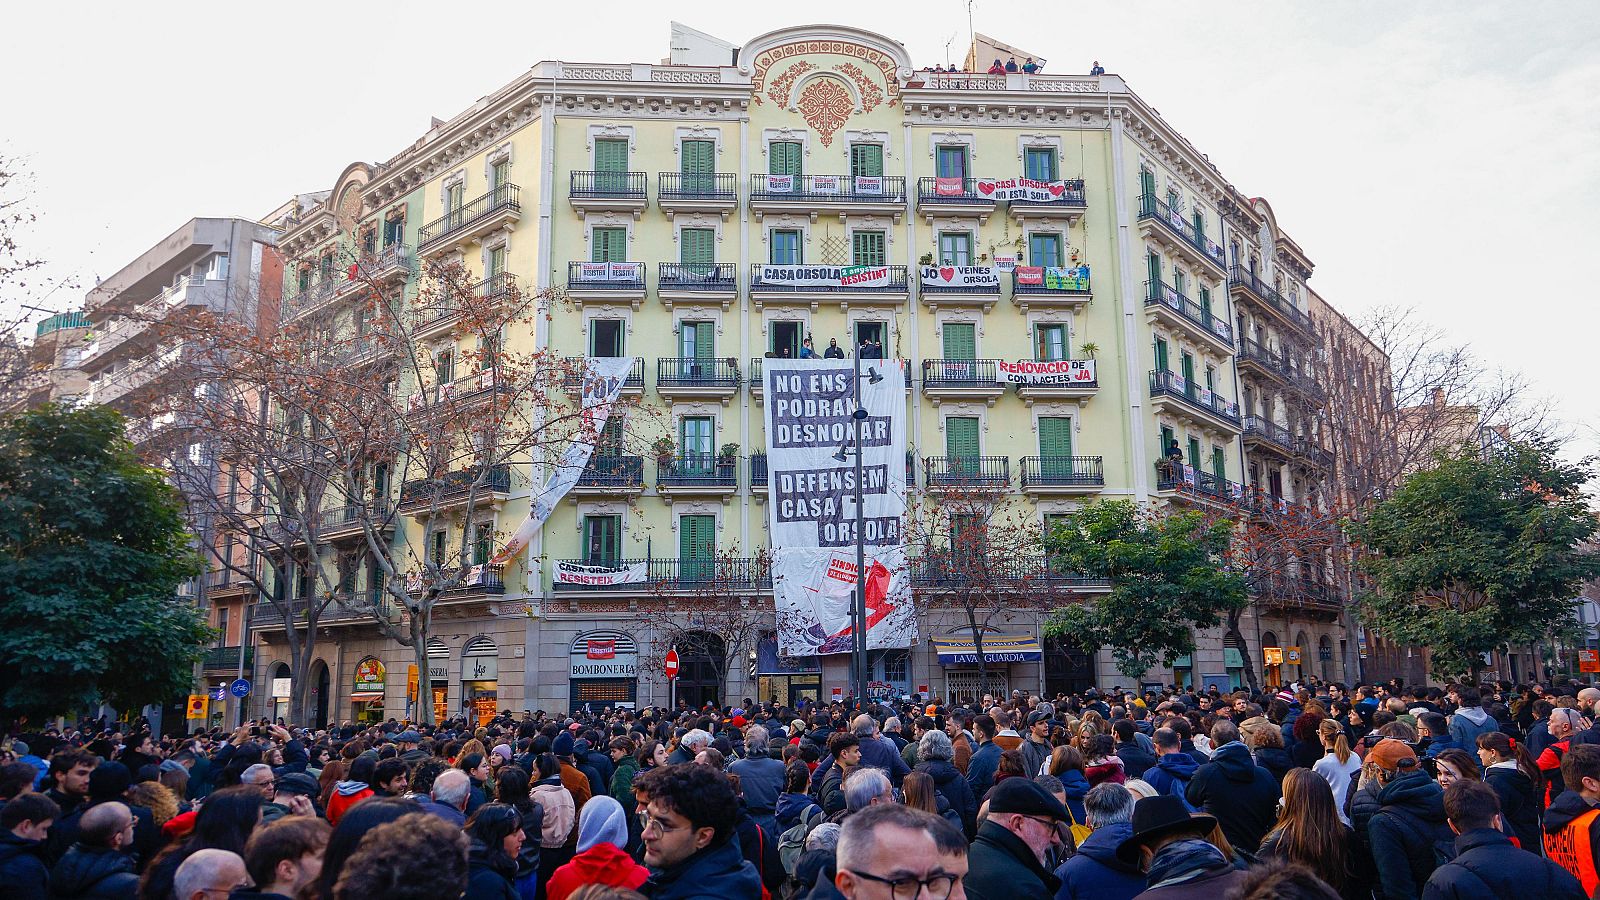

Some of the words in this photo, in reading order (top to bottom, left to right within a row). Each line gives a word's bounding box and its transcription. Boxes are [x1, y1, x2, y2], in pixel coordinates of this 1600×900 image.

[995, 179, 1016, 189] CASA
[995, 190, 1006, 199] NO
[1031, 191, 1050, 200] SOLA
[764, 268, 795, 280] CASA
[795, 268, 840, 280] ORSOLA
[841, 268, 887, 286] RESISTINT
[922, 268, 938, 279] JO
[957, 267, 990, 275] VEINES
[963, 275, 999, 283] ORSOLA
[999, 361, 1069, 374] RENOVACIO
[1071, 361, 1086, 370] DE
[1074, 369, 1091, 381] JA
[776, 374, 802, 393] NO
[810, 373, 847, 393] ENS
[777, 398, 859, 417] PODRAN
[777, 420, 887, 444] DESNONAR
[780, 469, 884, 494] DEFENSEM
[781, 497, 836, 518] CASA
[558, 563, 585, 573] CASA
[831, 558, 870, 575] SINDICT
[560, 573, 614, 585] RESISTEIX
